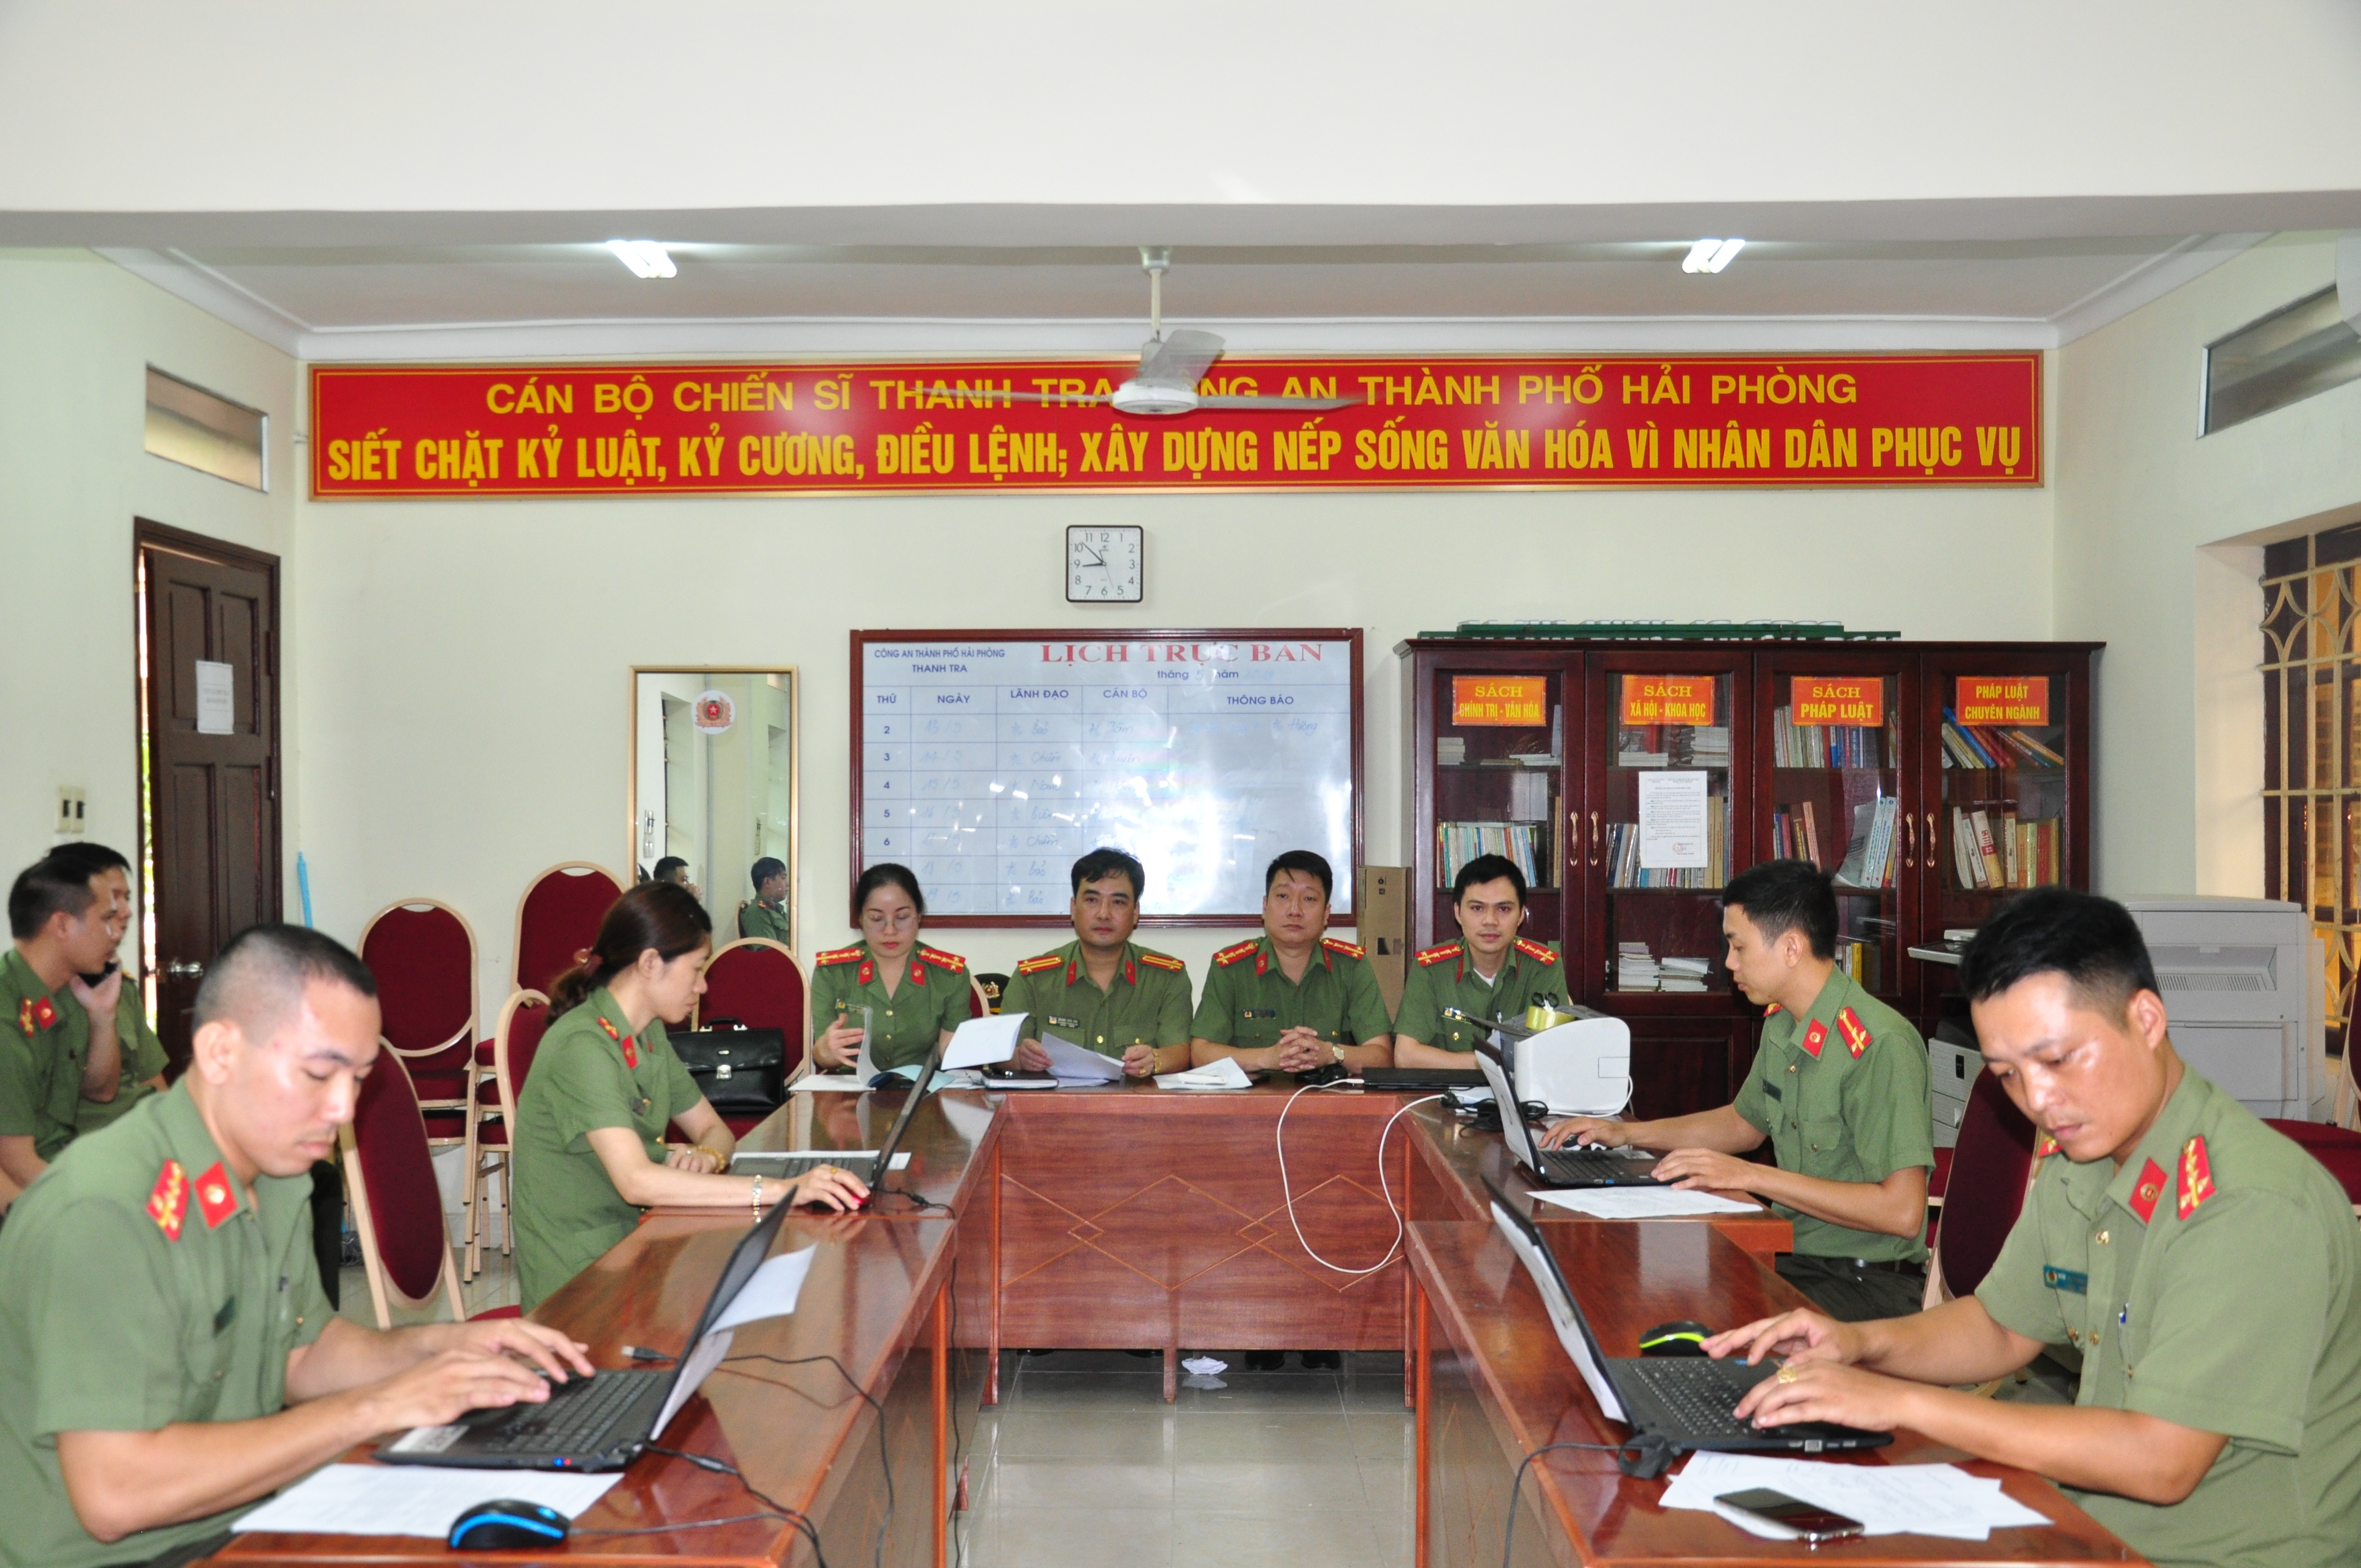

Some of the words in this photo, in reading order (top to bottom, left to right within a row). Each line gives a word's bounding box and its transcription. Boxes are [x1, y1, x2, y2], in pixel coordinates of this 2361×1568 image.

[486, 377, 574, 416] CÁN
[594, 374, 655, 420] BỘ
[673, 371, 794, 412] CHIẾN
[814, 373, 851, 410] SĨ
[869, 379, 1013, 410] THANH
[1032, 378, 1116, 409] TRA
[1281, 376, 1336, 402] AN
[1358, 367, 1500, 406] THÀNH
[1518, 364, 1603, 405] PHỐ
[1623, 363, 1690, 405] HẢI
[1711, 366, 1857, 405] PHÒNG
[328, 428, 402, 480] SIẾT
[415, 430, 504, 487] CHẶT
[517, 423, 563, 478] KỶ
[577, 424, 667, 486] LUẬT,
[678, 422, 725, 477] KỶ
[738, 430, 865, 480] CƯƠNG,
[875, 421, 954, 475] ĐIỀU
[969, 424, 1068, 482] LỆNH;
[1080, 422, 1149, 473] XÂY
[1162, 427, 1259, 480] DỰNG
[1274, 416, 1342, 471] NẾP
[1354, 415, 1449, 470] SỐNG
[1462, 421, 1530, 470] VĂN
[1544, 419, 1614, 469] HÓA
[1626, 421, 1658, 469] VÌ
[1673, 420, 1770, 469] NHÂN
[1785, 418, 1857, 469] DÂN
[1872, 424, 1961, 475] PHỤC
[1976, 426, 2021, 475] VỤ
[1085, 533, 1092, 542] 11
[1100, 533, 1109, 542] 12
[1074, 543, 1083, 553] 10
[1128, 544, 1135, 553] 2
[1074, 559, 1080, 568] 9
[1129, 560, 1135, 569] 3
[1075, 575, 1081, 585] 8
[1128, 576, 1134, 585] 4
[1085, 586, 1091, 595] 7
[1101, 587, 1107, 595] 6
[1118, 586, 1124, 595] 5
[875, 647, 899, 658] CÔNG
[902, 649, 913, 658] AN
[916, 646, 940, 658] THÀNH
[943, 646, 959, 657] PHỐ
[962, 647, 974, 657] HẢI
[977, 647, 1005, 658] PHÒNG
[1041, 644, 1128, 667] LỊCH
[1141, 642, 1238, 666] TRỰC
[1251, 643, 1322, 662] BAN
[1157, 669, 1188, 680] tháng
[1011, 689, 1039, 699] LÃNH
[1043, 690, 1068, 700] ĐẠO
[1103, 688, 1128, 699] CÁN
[1131, 688, 1147, 700] BỘ
[1475, 683, 1523, 698] SÁCH
[1644, 683, 1691, 697] SÁCH
[1813, 684, 1860, 698] SÁCH
[1976, 683, 2002, 699] PHÁP
[2005, 683, 2028, 701] LUẬT
[877, 693, 896, 704] THỨ
[937, 695, 970, 704] NGÀY
[1227, 694, 1266, 705] THÔNG
[1270, 695, 1294, 704] BÁO
[1460, 700, 1483, 717] CHÍNH
[1486, 704, 1498, 721] TRỊ
[1505, 701, 1521, 717] VĂN
[1524, 701, 1539, 718] HÓA
[1630, 700, 1641, 716] XÃ
[1644, 700, 1657, 719] HỘI
[1665, 703, 1687, 717] KHOA
[1689, 703, 1706, 720] HỌC
[1800, 701, 1836, 718] PHÁP
[1841, 701, 1873, 721] LUẬT
[1965, 704, 2003, 719] CHUYÊN
[2006, 704, 2040, 719] NGÀNH
[883, 726, 890, 734] 2
[883, 781, 890, 790] 4
[883, 809, 890, 818] 5
[883, 837, 890, 846] 6
